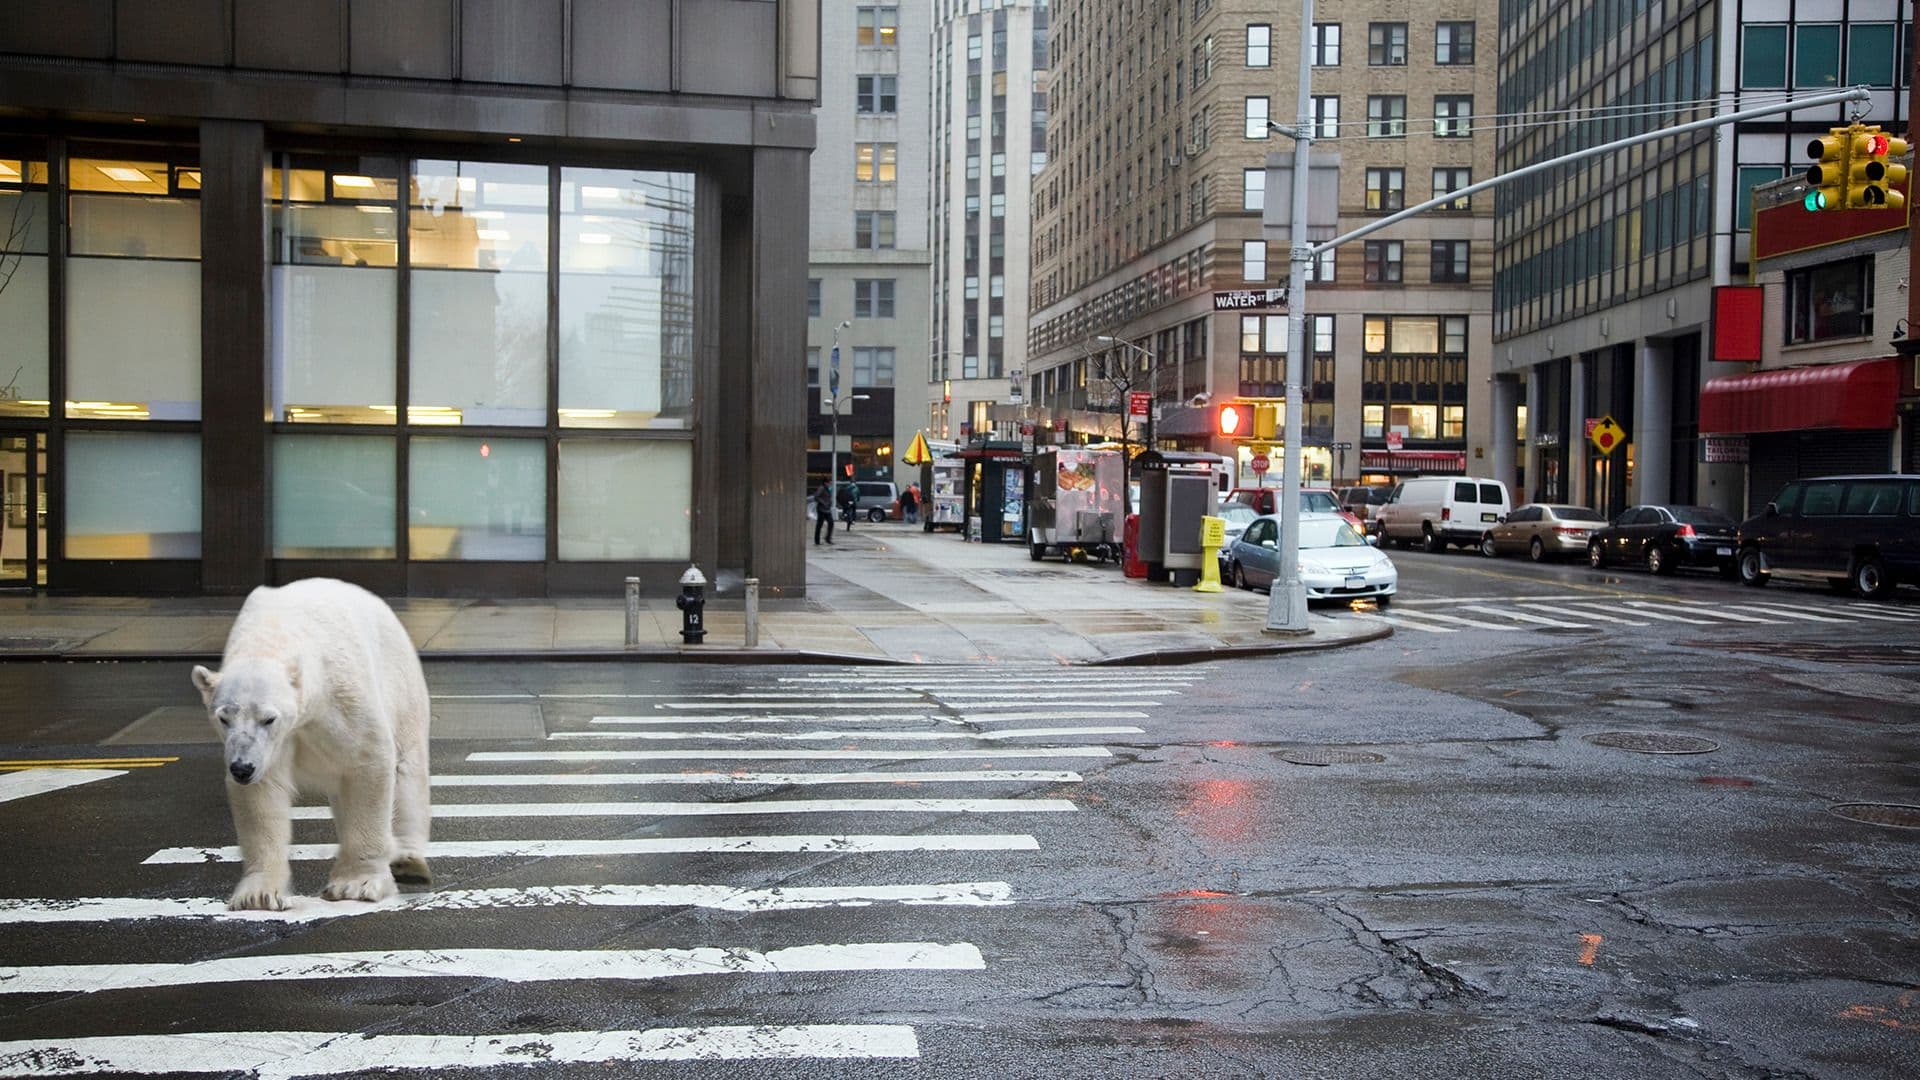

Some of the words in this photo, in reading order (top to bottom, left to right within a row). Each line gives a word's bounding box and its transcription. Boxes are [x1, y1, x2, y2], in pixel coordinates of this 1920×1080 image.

[1215, 295, 1257, 308] WATER
[1252, 460, 1269, 469] STOP
[689, 614, 699, 625] 12
